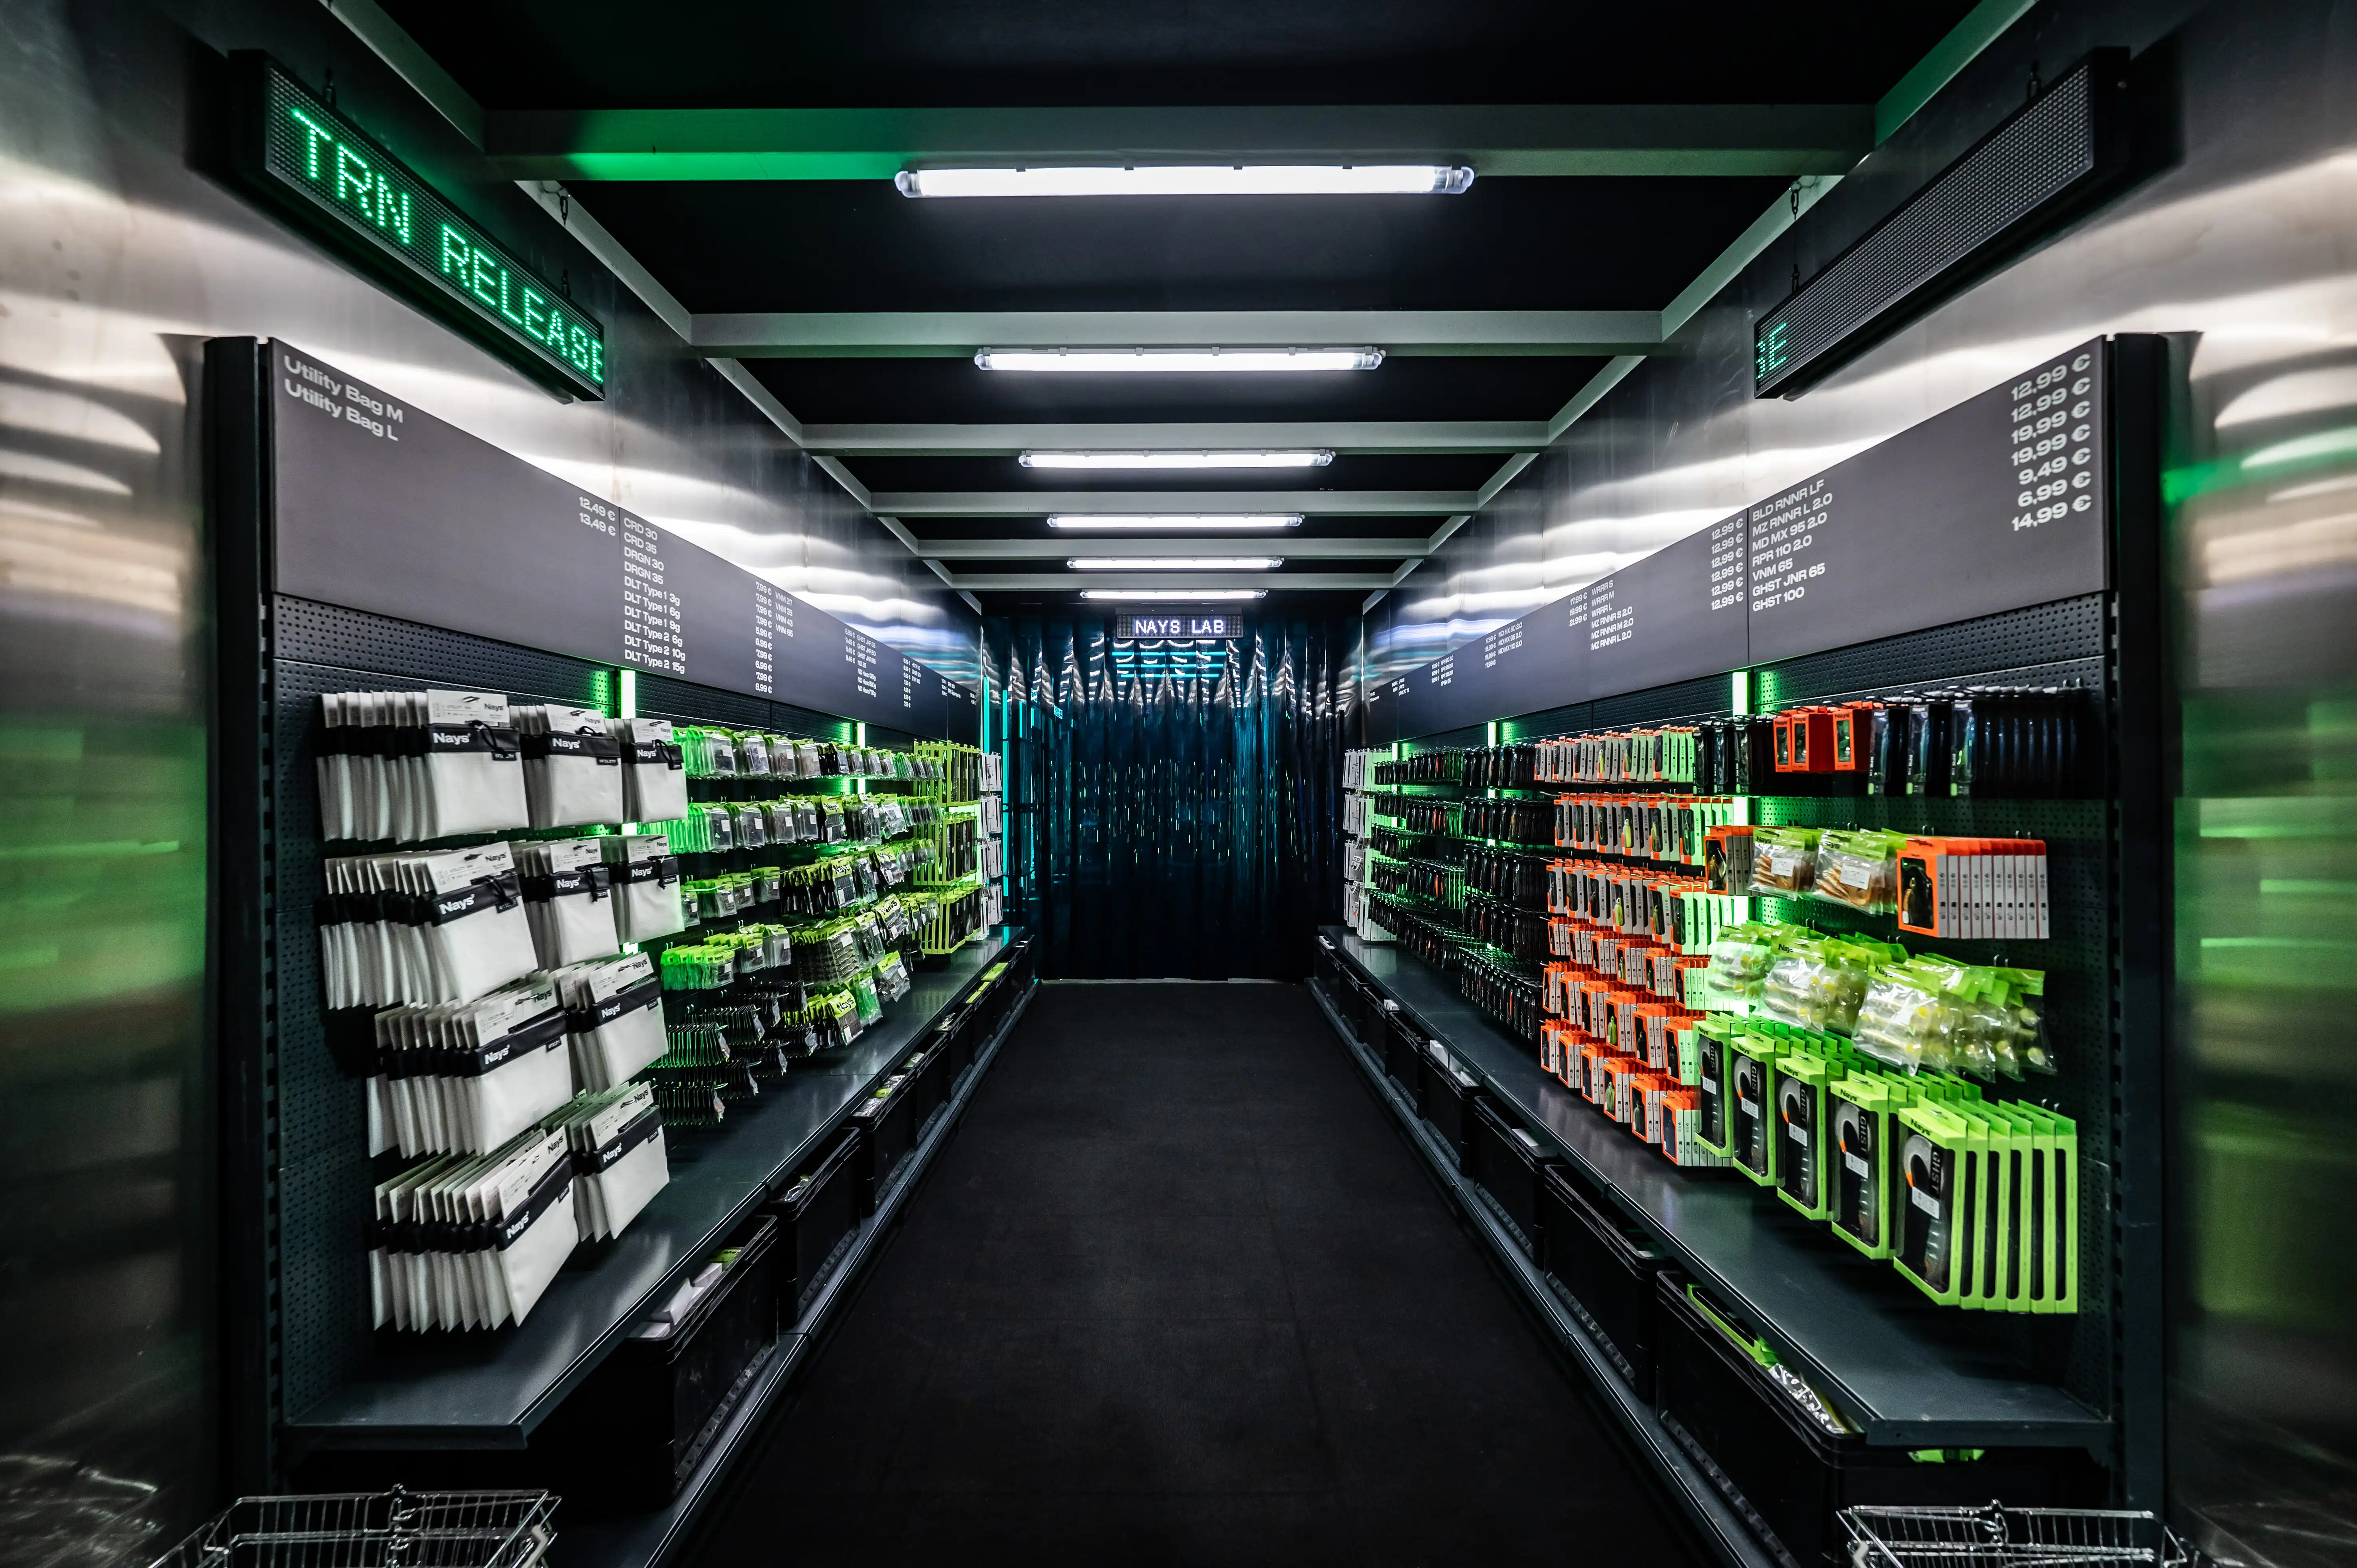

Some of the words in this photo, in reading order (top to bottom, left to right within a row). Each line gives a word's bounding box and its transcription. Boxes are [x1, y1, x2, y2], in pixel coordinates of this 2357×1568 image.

[292, 109, 409, 243] TRN
[442, 224, 602, 383] RELEASE
[284, 355, 342, 396] Utility
[346, 384, 383, 416] Bag
[386, 404, 403, 423] M
[2011, 365, 2067, 401] 12,99
[2071, 354, 2091, 372] €
[284, 379, 343, 418] Utility
[346, 406, 384, 437] Bag
[387, 425, 399, 441] L
[2011, 387, 2067, 423] 12,99
[2071, 377, 2091, 395] €
[2011, 410, 2067, 444] 19,99
[2071, 401, 2091, 419] €
[2011, 433, 2067, 466] 19,99
[2071, 424, 2091, 442] €
[2018, 456, 2067, 485] 9,49
[2071, 447, 2091, 465] €
[1753, 504, 1773, 522] BLD
[1775, 488, 1807, 511] RNNR
[1810, 479, 1825, 496] LF
[2017, 479, 2067, 507] 6,99
[2071, 471, 2091, 488] €
[579, 496, 606, 517] 12,49
[607, 510, 616, 521] €
[1753, 521, 1768, 537] MZ
[1769, 508, 1801, 528] RNNR
[1804, 504, 1811, 514] L
[1812, 493, 1833, 510] 2.0
[2011, 502, 2068, 531] 14,99
[2072, 494, 2091, 512] €
[579, 512, 606, 532] 13,49
[608, 525, 616, 536] €
[624, 518, 644, 534] CRD
[645, 528, 657, 540] 30
[1712, 522, 1734, 540] 12,99
[1736, 518, 1743, 528] €
[1752, 537, 1769, 552] MD
[1771, 528, 1788, 545] MX
[1790, 520, 1805, 536] 95
[1807, 512, 1827, 529] 2.0
[624, 532, 644, 548] CRD
[645, 542, 657, 554] 35
[1753, 550, 1773, 567] RPR
[1775, 543, 1791, 558] 110
[1793, 534, 1812, 551] 2.0
[624, 546, 651, 566] DRGN
[652, 559, 664, 571] 30
[1753, 564, 1776, 582] VNM
[1778, 558, 1793, 572] 65
[624, 561, 651, 580] DRGN
[652, 573, 663, 585] 35
[1753, 578, 1782, 597] GHST
[1783, 569, 1807, 586] JNR
[1809, 562, 1825, 578] 65
[624, 576, 641, 590] DLT
[669, 593, 680, 606] 3g
[775, 591, 786, 603] VNM
[1712, 594, 1734, 610] 12,99
[1736, 591, 1743, 601] €
[1753, 594, 1782, 611] GHST
[1783, 587, 1805, 602] 100
[624, 605, 641, 619] DLT
[669, 620, 680, 633] 9g
[775, 602, 786, 613] VNM
[786, 608, 793, 616] 35
[775, 613, 786, 624] VNM
[1591, 620, 1600, 629] MZ
[1600, 612, 1616, 625] RNNR
[1617, 610, 1621, 619] S
[1622, 606, 1632, 617] 2.0
[776, 623, 787, 635] VNM
[787, 629, 793, 637] 65
[1136, 620, 1180, 633] NAYS
[1192, 620, 1224, 633] LAB
[1591, 630, 1600, 639] MZ
[1600, 624, 1616, 636] RNNR
[1617, 621, 1622, 630] M
[1623, 617, 1634, 628] 2.0
[1591, 641, 1600, 650] MZ
[1600, 635, 1616, 648] RNNR
[1622, 630, 1632, 640] 2.0
[625, 649, 641, 662] DLT
[672, 662, 685, 674] 15g
[432, 732, 471, 745] Nays
[552, 738, 580, 749] Nays
[637, 749, 657, 758] Nays
[556, 877, 580, 889] Nays
[631, 867, 652, 877] Nays
[439, 894, 475, 914] Nays
[601, 1003, 621, 1018] Nays
[485, 1044, 510, 1065] Nays
[602, 1143, 622, 1163] Nays
[1932, 1151, 1940, 1194] GHST
[506, 1211, 529, 1239] Nays
